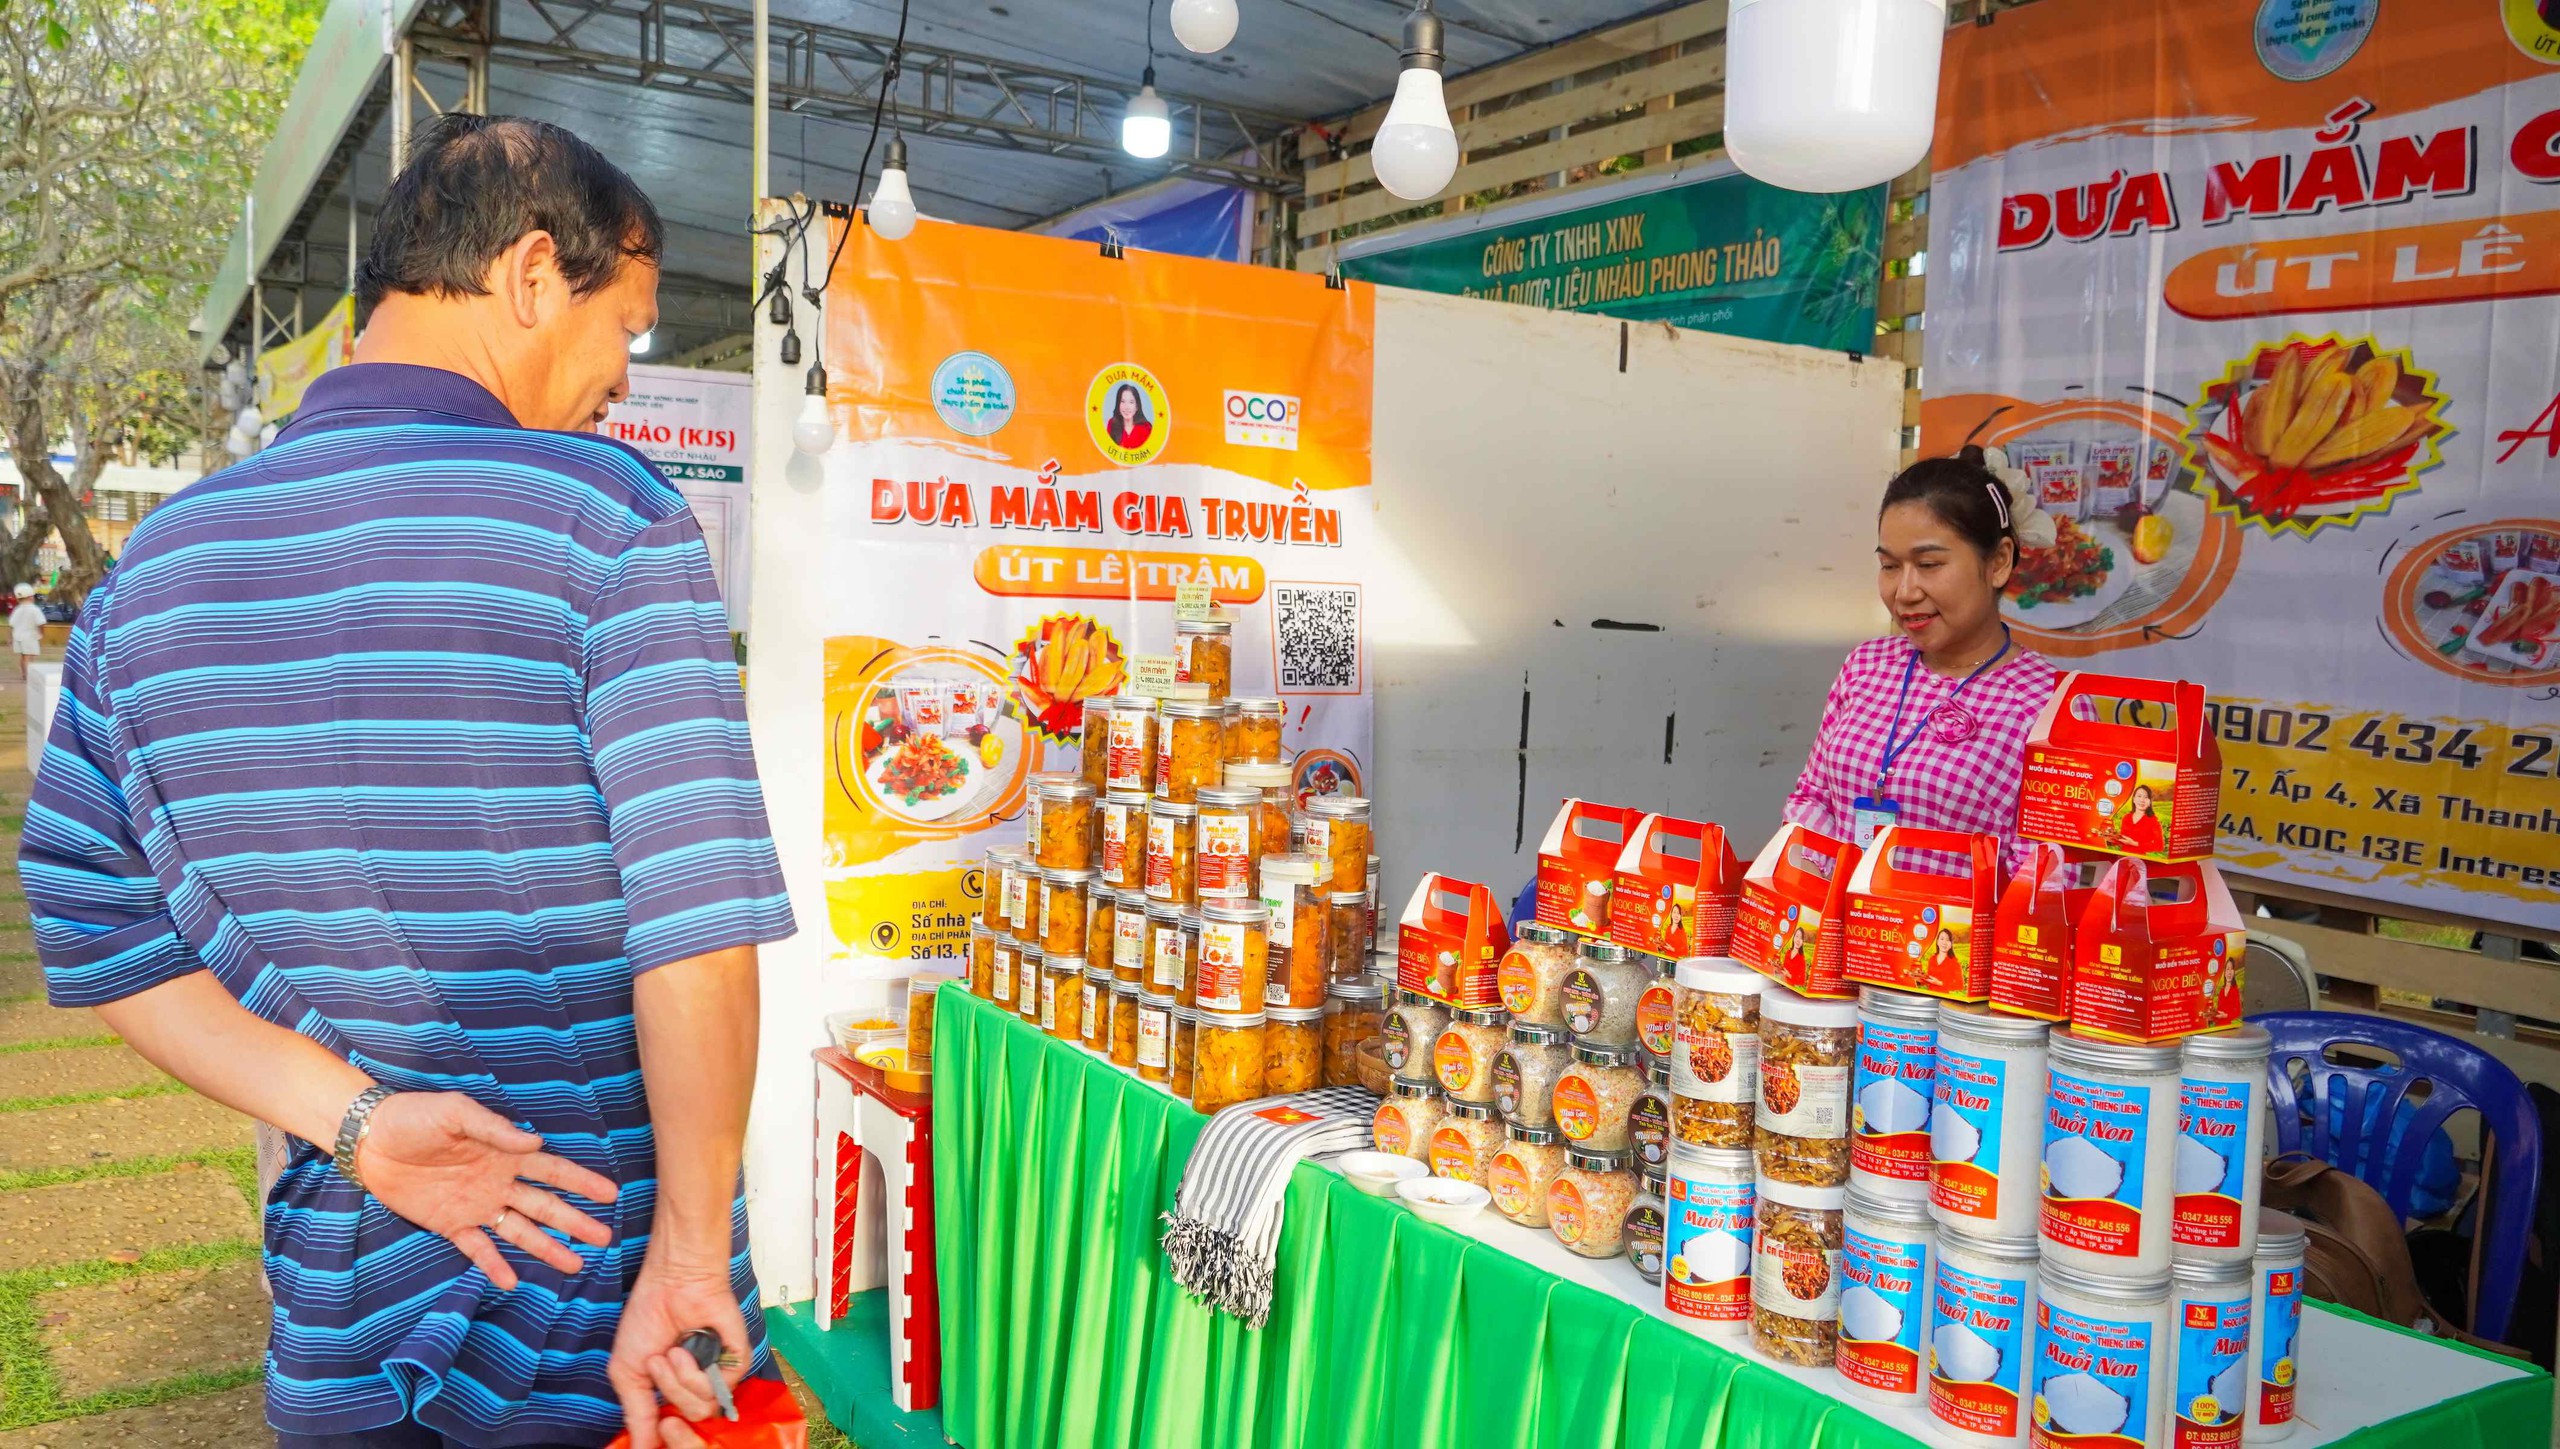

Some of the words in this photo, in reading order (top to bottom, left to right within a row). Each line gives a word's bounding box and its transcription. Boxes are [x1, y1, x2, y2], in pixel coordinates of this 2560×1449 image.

[2534, 33, 2557, 54] ÚT
[1997, 168, 2177, 252] DƯA
[2201, 96, 2477, 228] MẮM
[1482, 237, 1526, 278] CÔNG
[1530, 232, 1551, 270] TY
[1553, 221, 1600, 265] TNHH
[1605, 212, 1646, 255] XNK
[1554, 266, 1592, 310] LIỆU
[1595, 255, 1646, 303] NHÀU
[1650, 247, 1718, 295] PHONG
[1722, 227, 1781, 284] THẢO
[2214, 246, 2360, 299] ÚT
[2392, 223, 2528, 284] LÊ
[1227, 395, 1298, 423] OCOP
[605, 419, 671, 443] THẢO
[679, 427, 736, 453] (KJS)
[664, 449, 684, 460] CỐT
[686, 450, 717, 462] NHÀU
[684, 466, 695, 477] 4
[697, 468, 727, 480] SAO
[871, 475, 977, 527] DƯA
[989, 459, 1102, 532] MẮM
[1112, 490, 1191, 537] GIA
[1200, 477, 1341, 547] TRUYỀN
[1000, 549, 1063, 583] ÚT
[1076, 554, 1125, 587] LÊ
[1138, 557, 1250, 590] TRÂM
[2350, 718, 2482, 770] 434
[2507, 734, 2560, 779] 2
[2023, 779, 2060, 797] NGỌC
[2064, 780, 2096, 801] BIỂN
[2231, 768, 2257, 796] 7,
[2268, 767, 2312, 804] Ấp
[2324, 782, 2358, 810] 4,
[2372, 787, 2421, 816] Xã
[2217, 813, 2263, 842] 4A,
[2275, 821, 2348, 855] KDC
[2361, 834, 2425, 867] 13E
[912, 901, 927, 910] ĐỊA
[929, 899, 947, 909] CHỈ:
[912, 913, 934, 928] Số
[936, 912, 966, 928] nhà
[912, 932, 927, 942] ĐỊA
[929, 931, 945, 940] CHỈ
[1845, 923, 1877, 940] NGỌC
[1880, 925, 1907, 944] BIỂN
[911, 944, 934, 960] Số
[937, 944, 957, 960] 13,
[1881, 1040, 1897, 1052] LONG
[1862, 1054, 1899, 1079] Muối
[1901, 1061, 1936, 1080] Non
[1953, 1088, 1990, 1111] Non
[2068, 1095, 2086, 1107] LONG
[2048, 1107, 2088, 1135] Muối
[2090, 1119, 2135, 1143] Non
[2194, 1117, 2237, 1137] Non
[1892, 1147, 1910, 1158] 0347
[1911, 1150, 1924, 1160] 345
[1943, 1178, 1958, 1191] 0347
[1959, 1182, 1972, 1193] 345
[1973, 1185, 1988, 1197] 556
[1707, 1196, 1723, 1206] LONG
[1684, 1209, 1726, 1230] Muối
[2059, 1211, 2072, 1221] 667
[2077, 1215, 2097, 1228] 0347
[2098, 1220, 2114, 1232] 345
[2115, 1223, 2131, 1234] 556
[2182, 1211, 2201, 1222] 0347
[2203, 1213, 2219, 1224] 345
[2219, 1215, 2233, 1225] 556
[2204, 1236, 2219, 1244] HCM
[1874, 1272, 1912, 1294] Non
[1952, 1284, 1967, 1297] LONG
[1690, 1289, 1703, 1300] 800
[1703, 1291, 1716, 1301] 667
[1720, 1292, 1736, 1303] 0347
[1937, 1293, 1969, 1323] Muối
[1970, 1309, 2011, 1332] Non
[2071, 1331, 2091, 1344] LONG
[1863, 1355, 1880, 1368] 0347
[1881, 1359, 1895, 1371] 345
[1895, 1361, 1909, 1373] 556
[2045, 1341, 2093, 1372] Muối
[2096, 1357, 2139, 1377] Non
[1959, 1397, 1976, 1410] 0347
[1978, 1402, 1993, 1414] 345
[1994, 1404, 2009, 1416] 556
[2195, 1401, 2217, 1410] 100%
[2185, 1431, 2199, 1441] ĐT:
[2201, 1432, 2219, 1442] 0352
